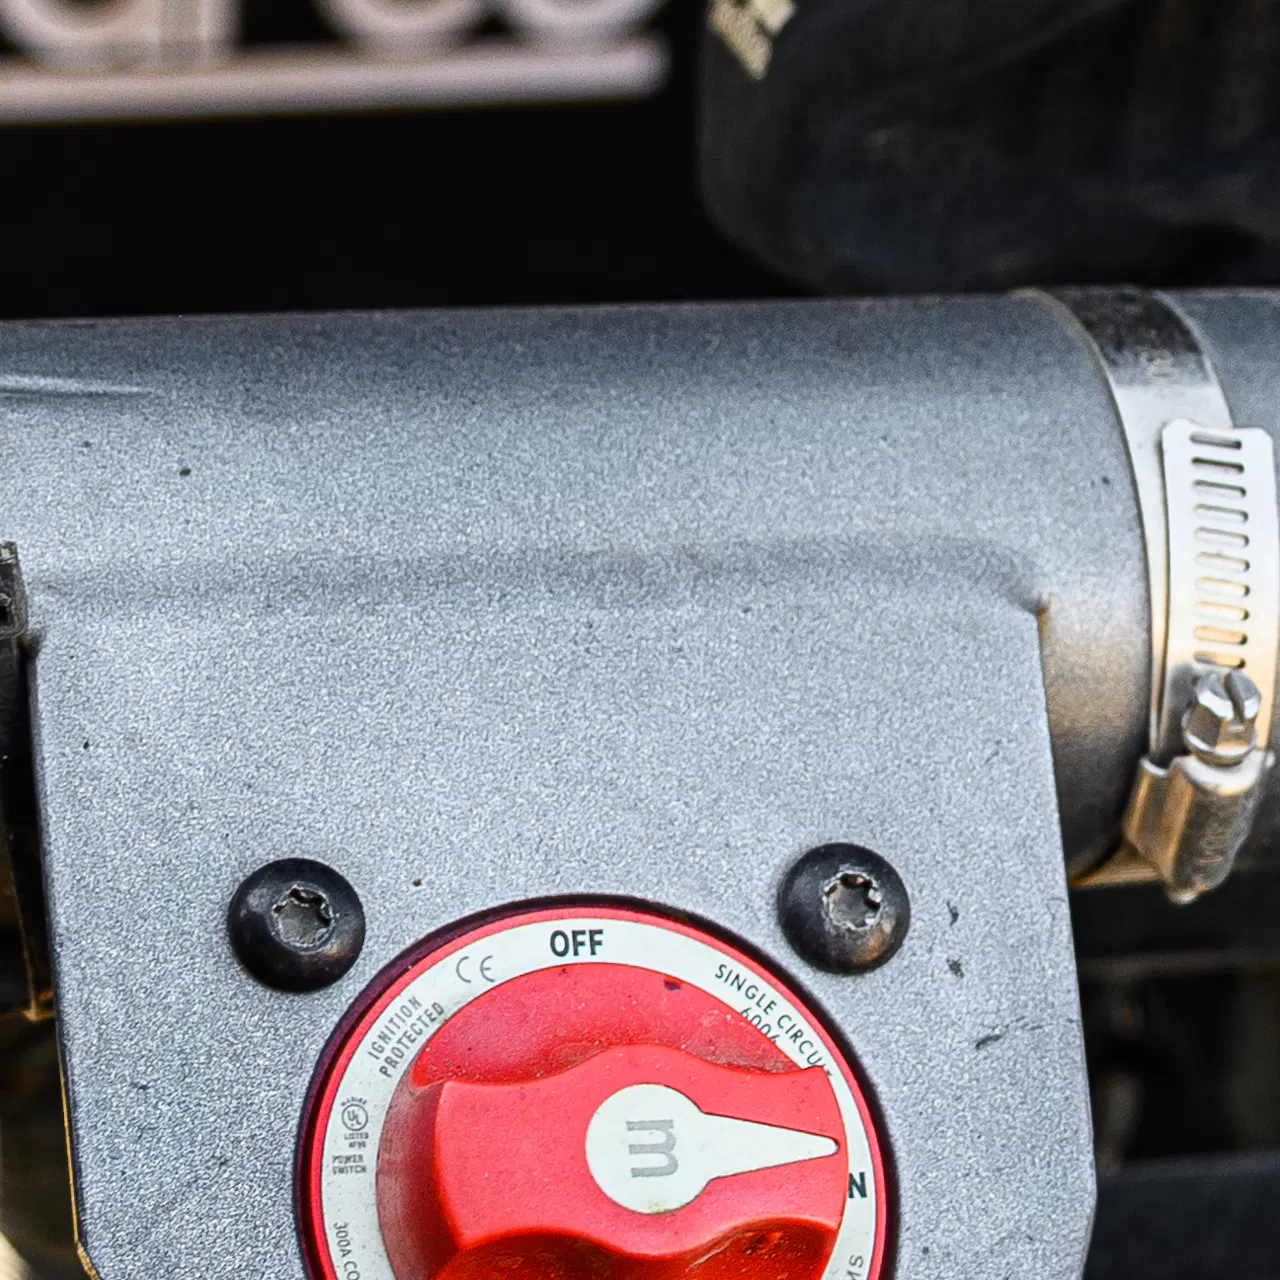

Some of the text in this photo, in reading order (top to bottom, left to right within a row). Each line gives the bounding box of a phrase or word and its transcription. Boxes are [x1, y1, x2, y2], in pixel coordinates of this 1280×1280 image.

[550, 929, 604, 957] OFF
[456, 955, 496, 983] CE
[368, 996, 422, 1060] IGNITION
[715, 964, 833, 1076] SINGLE CIRCU
[378, 1002, 445, 1078] PROTECTED
[332, 1154, 365, 1164] POWER
[332, 1165, 368, 1175] SWITCH
[333, 1221, 353, 1258] 300A
